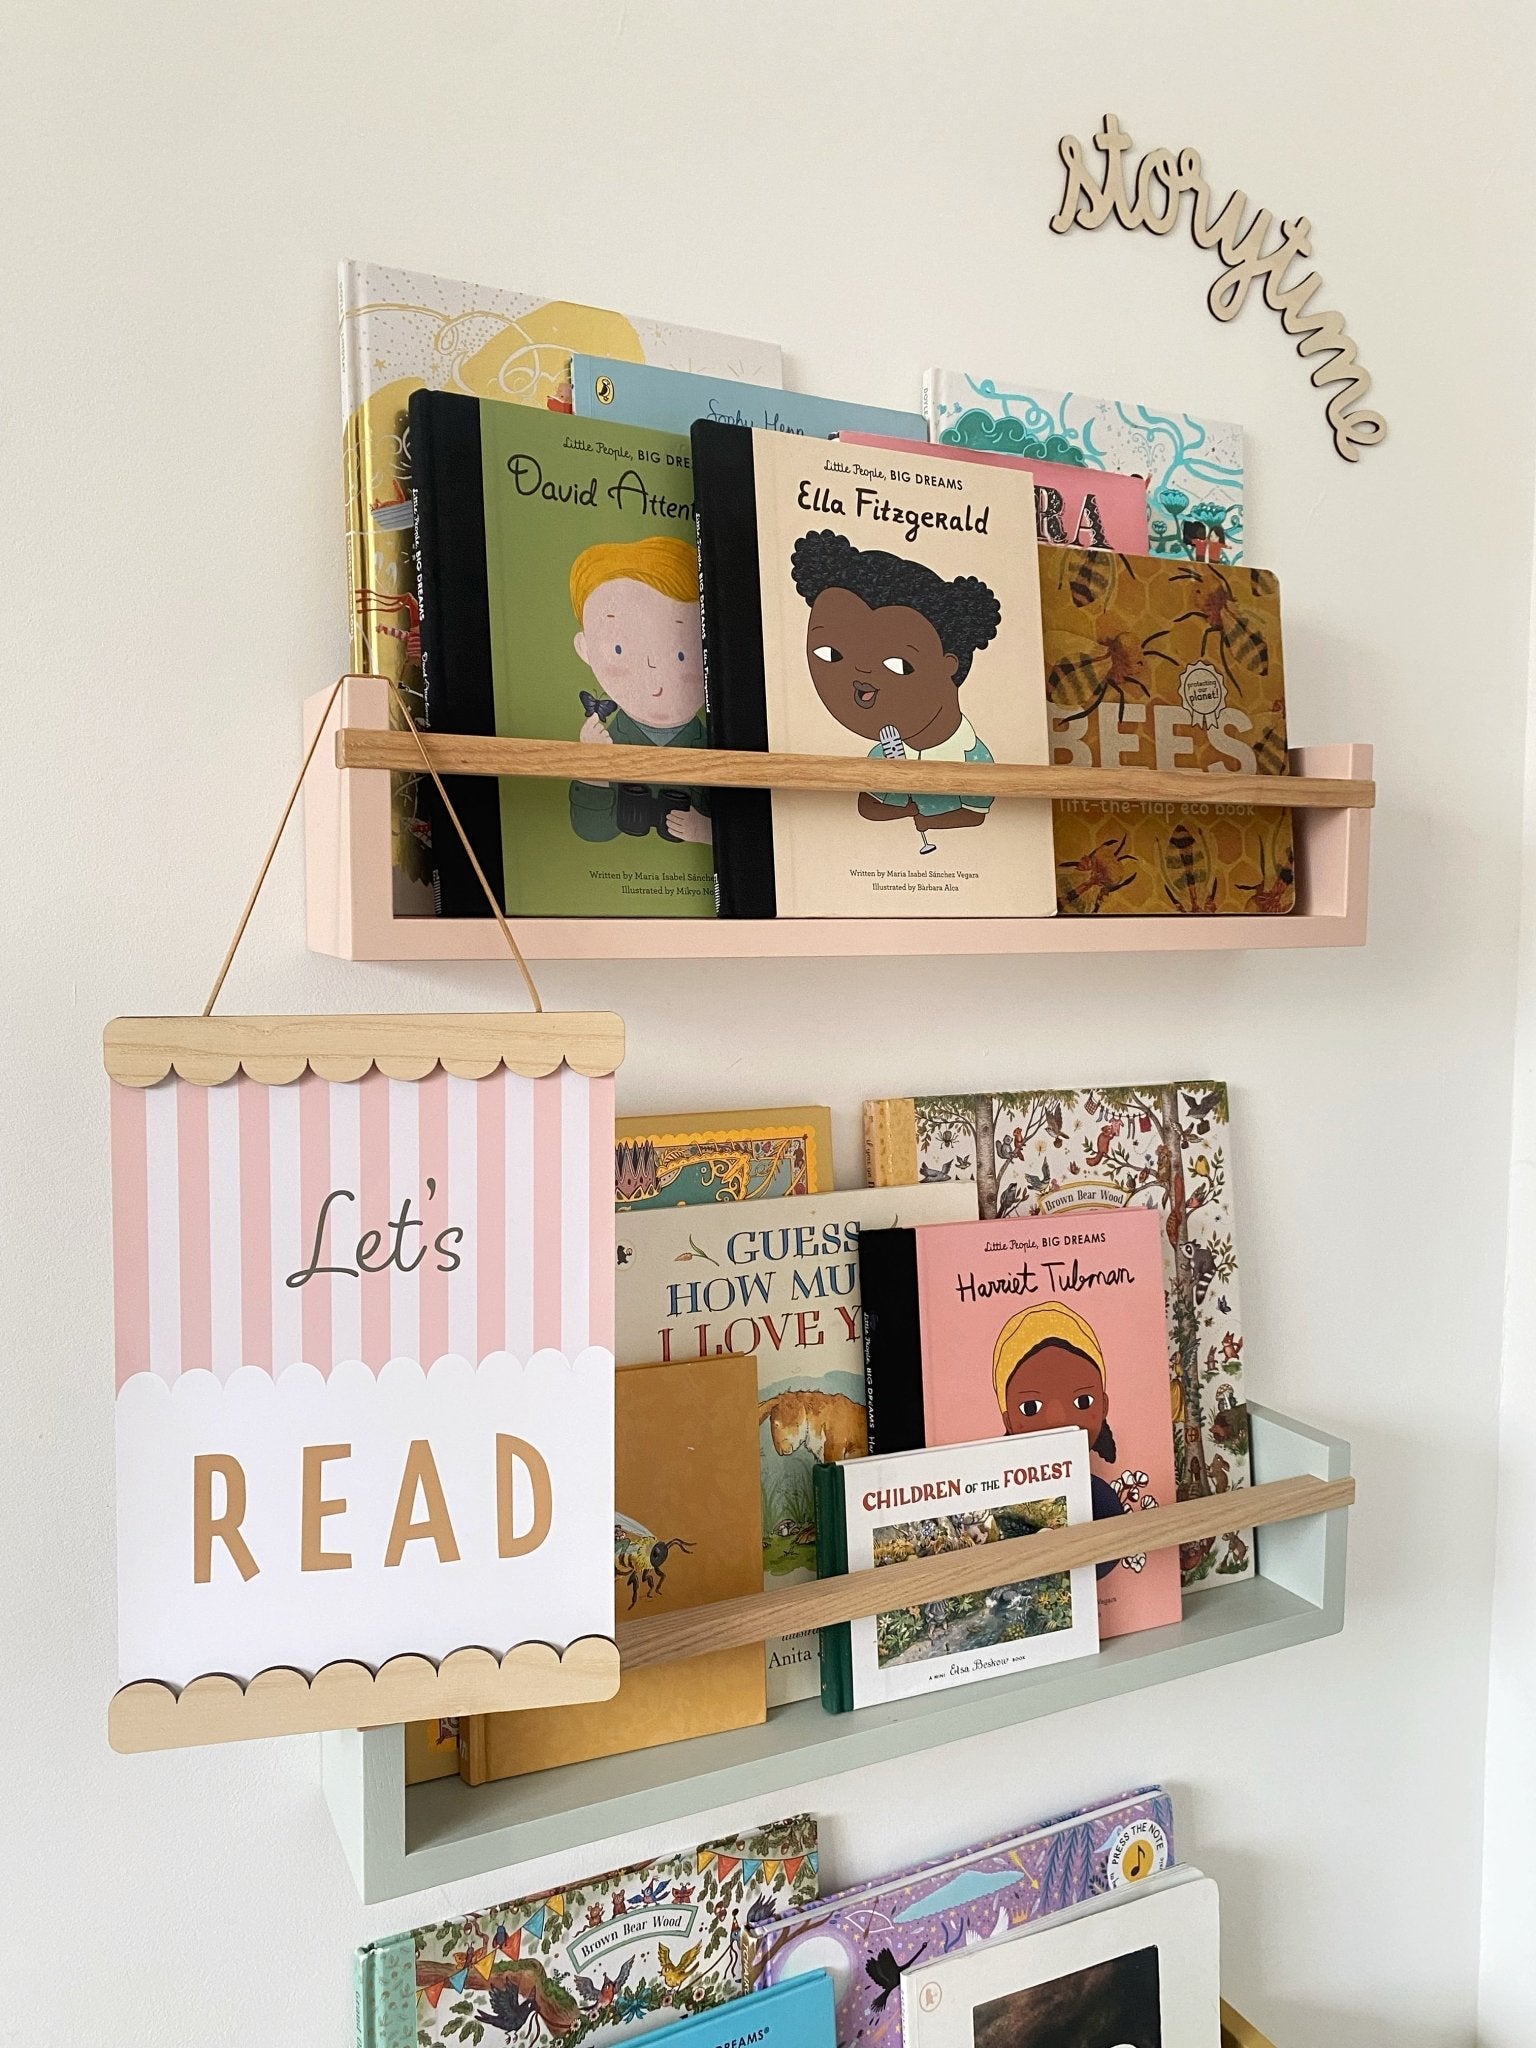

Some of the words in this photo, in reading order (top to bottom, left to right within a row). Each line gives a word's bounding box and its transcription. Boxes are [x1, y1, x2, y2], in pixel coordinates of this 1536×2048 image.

[1050, 113, 1387, 463] storytime
[563, 437, 593, 452] Little
[596, 442, 633, 461] People,
[637, 449, 660, 463] BIG
[666, 454, 693, 470] DRE
[507, 453, 597, 507] David
[824, 459, 851, 474] Little
[852, 463, 887, 481] People,
[890, 470, 910, 482] BIG
[915, 474, 963, 491] DREAMS
[798, 480, 846, 516] Ella
[416, 550, 424, 572] BIG
[1189, 688, 1219, 706] planet!
[1047, 702, 1257, 775] BEES
[589, 871, 621, 880] Written
[622, 871, 633, 882] by
[662, 873, 685, 881] Isabel
[622, 886, 662, 894] Illustrated
[664, 886, 674, 896] by
[849, 869, 876, 877] Written
[877, 869, 886, 879] by
[908, 870, 927, 878] Isabel
[957, 871, 979, 880] Vegara
[908, 884, 916, 892] by
[1045, 1193, 1074, 1212] Brown
[1077, 1190, 1097, 1200] Bear
[1100, 1190, 1124, 1205] Wood
[286, 1177, 464, 1288] Let's
[726, 1221, 861, 1265] GUESS
[984, 1241, 1008, 1252] Little
[1010, 1239, 1039, 1252] People,
[1042, 1236, 1060, 1248] BIG
[1064, 1232, 1106, 1246] DREAMS
[666, 1271, 776, 1317] HOW
[791, 1263, 857, 1300] MU
[956, 1262, 1038, 1302] Harriet
[1041, 1259, 1135, 1293] Tubman
[694, 1310, 824, 1357] LOVE
[867, 1387, 875, 1428] DREAMS
[862, 1479, 961, 1511] CHILDREN
[965, 1483, 978, 1494] OF
[981, 1479, 1000, 1491] THE
[1003, 1461, 1072, 1488] FOREST
[193, 1433, 553, 1585] READ
[768, 1647, 812, 1669] Anita
[949, 1663, 970, 1676] Elsa
[972, 1658, 1009, 1672] Beskow
[1112, 1832, 1130, 1865] PRESS
[1131, 1822, 1147, 1835] THE
[1148, 1824, 1164, 1850] NOTE
[581, 1931, 619, 1957] Brown
[623, 1921, 648, 1936] Bear
[653, 1915, 683, 1928] Wood
